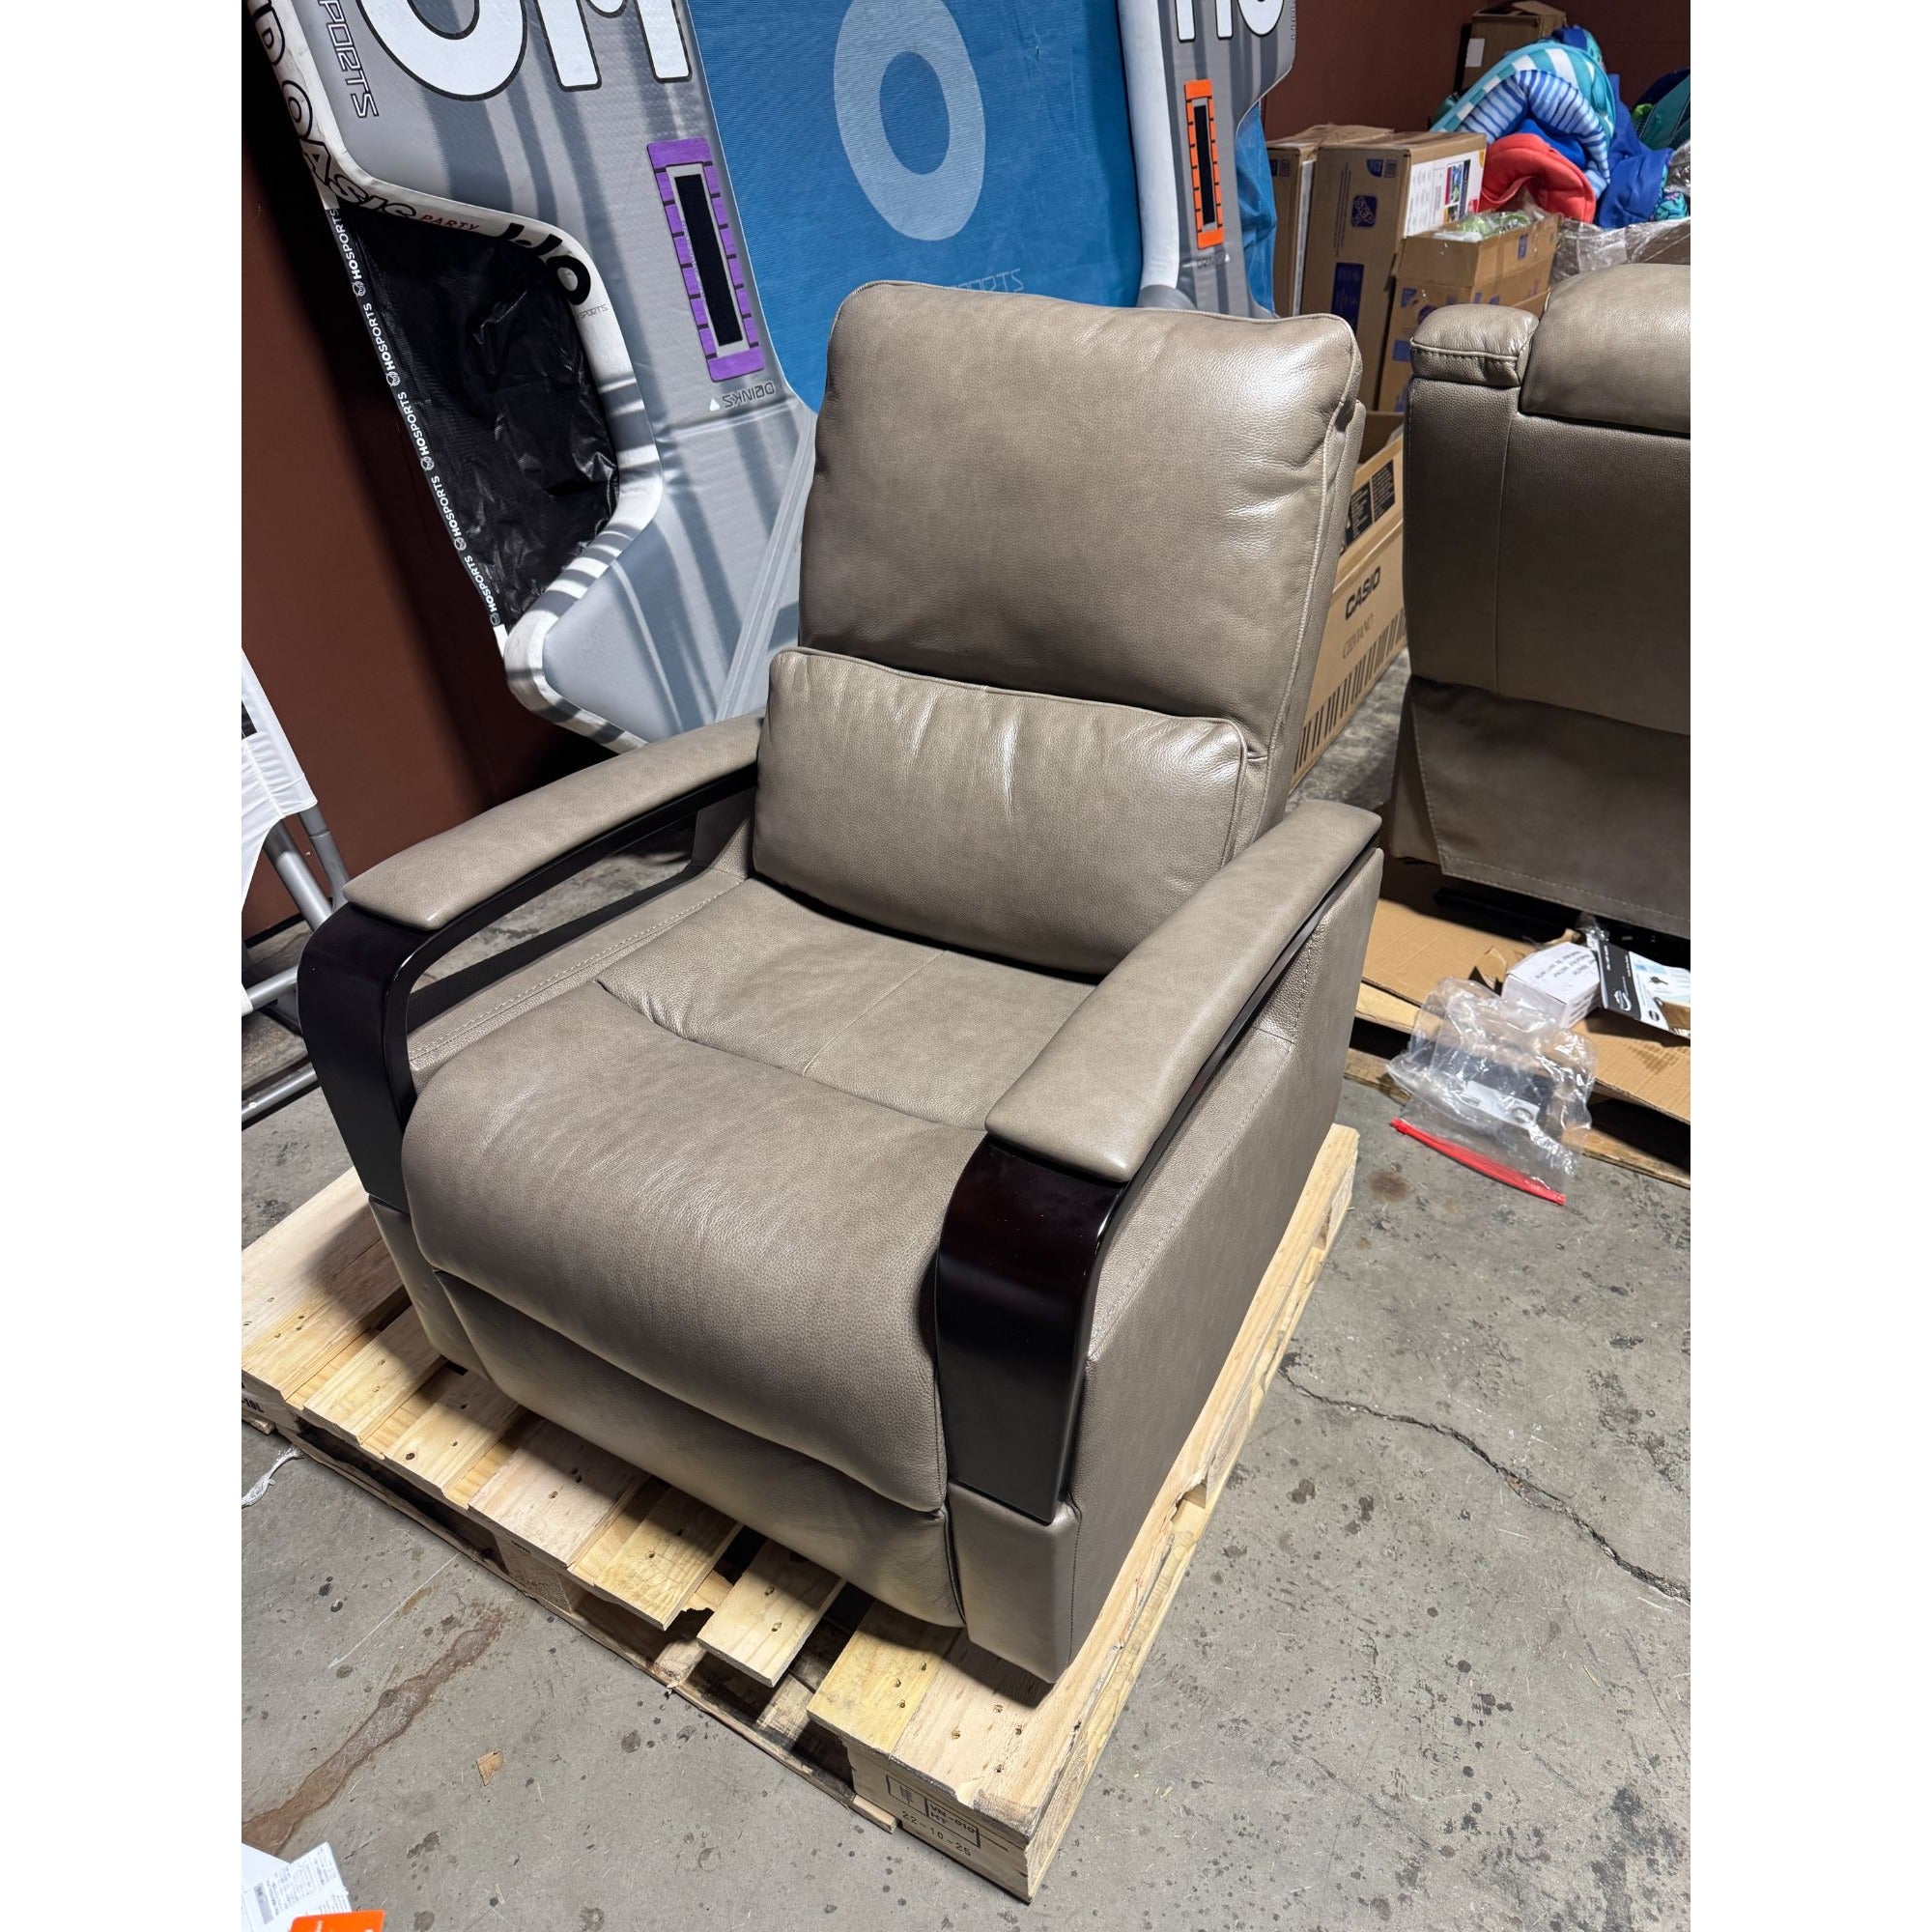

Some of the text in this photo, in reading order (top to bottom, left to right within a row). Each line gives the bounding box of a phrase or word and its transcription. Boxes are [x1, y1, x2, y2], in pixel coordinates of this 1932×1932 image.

[329, 209, 362, 279] HOSPORTS
[363, 302, 396, 371] HOSPORTS
[397, 391, 430, 456] HOSPORTS
[431, 475, 462, 538] HOSPORTS
[464, 555, 497, 613] HOSPORTS
[1345, 566, 1381, 620] CASIO
